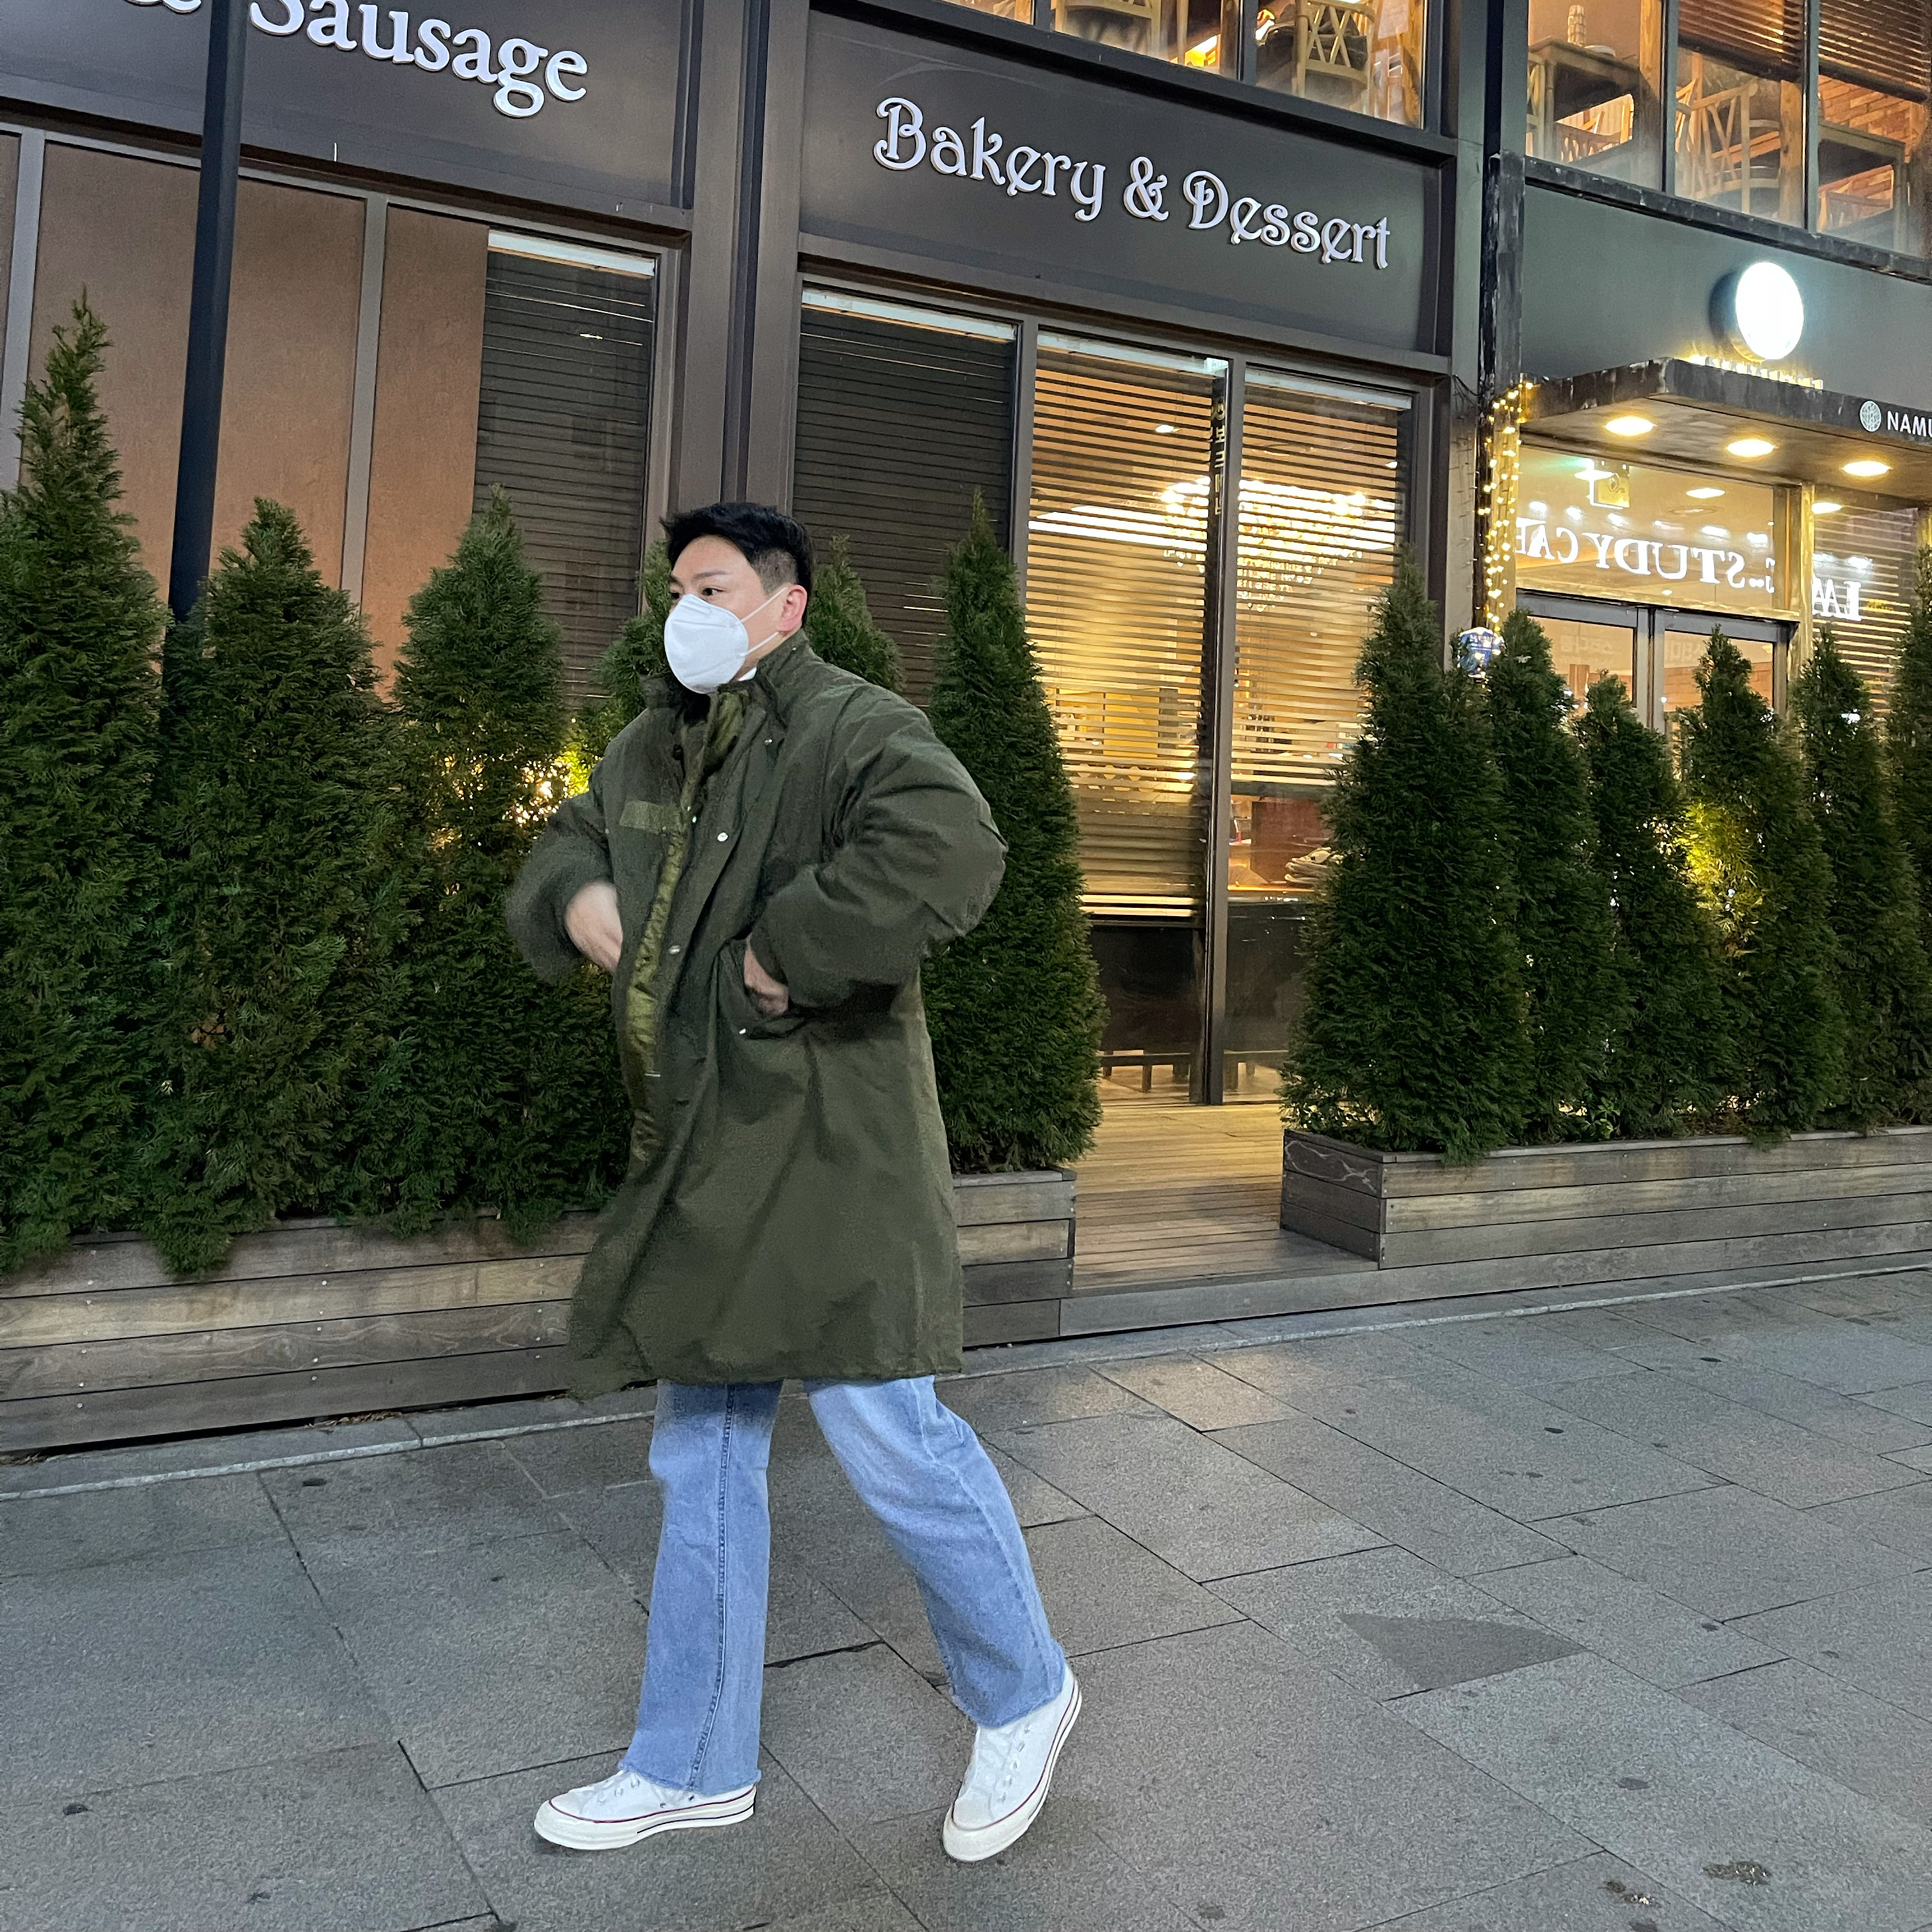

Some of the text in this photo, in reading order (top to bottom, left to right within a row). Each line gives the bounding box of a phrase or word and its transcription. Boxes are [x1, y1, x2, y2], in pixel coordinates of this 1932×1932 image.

[873, 97, 1390, 269] Bakery & Dessert
[1887, 410, 1932, 438] NAM
